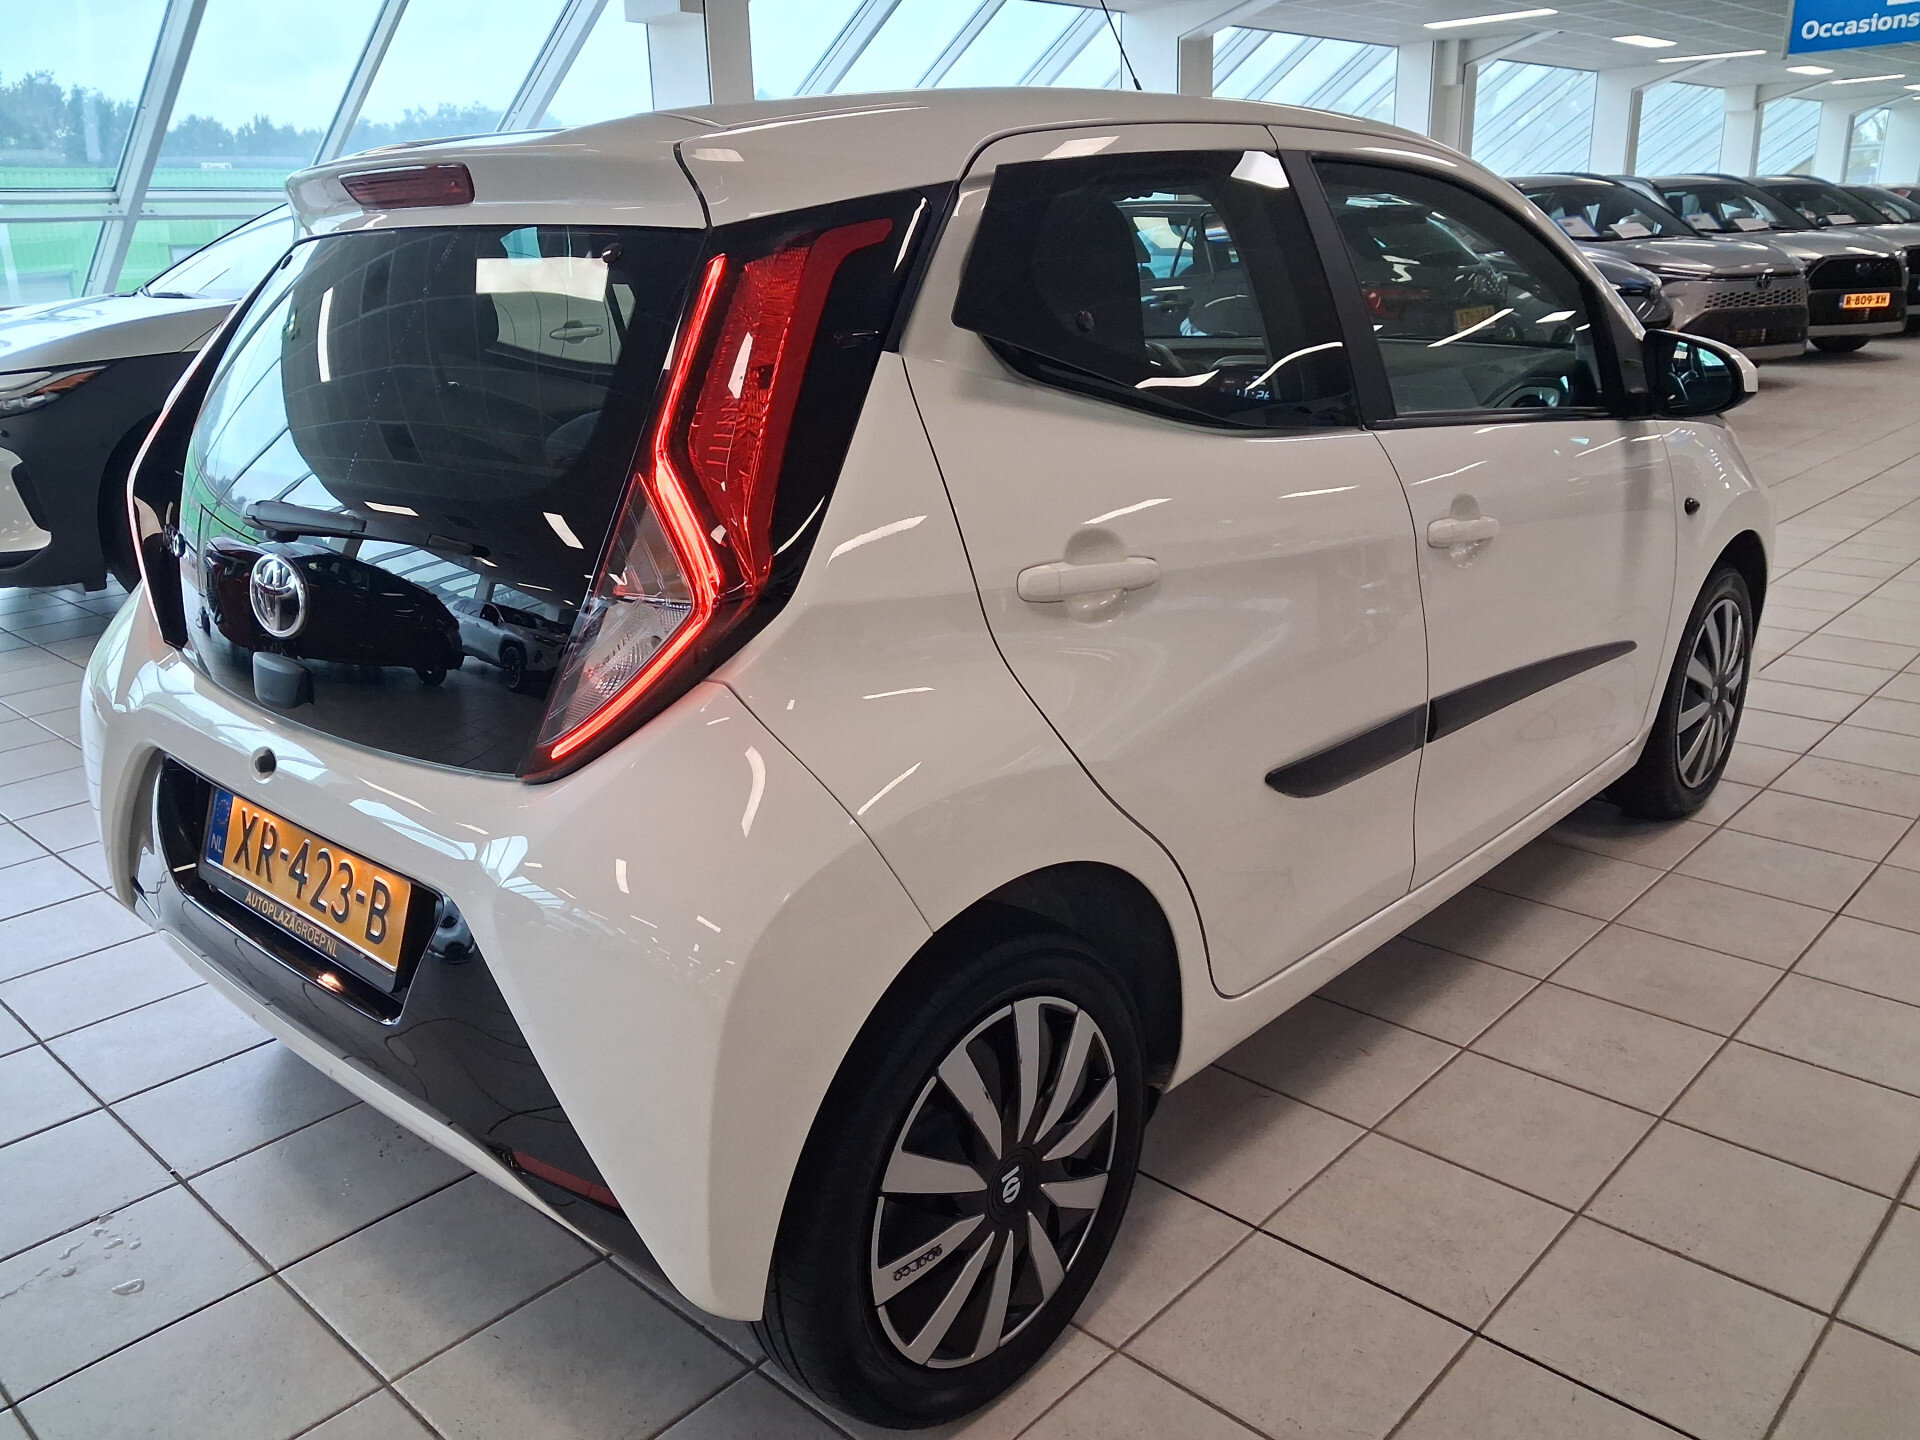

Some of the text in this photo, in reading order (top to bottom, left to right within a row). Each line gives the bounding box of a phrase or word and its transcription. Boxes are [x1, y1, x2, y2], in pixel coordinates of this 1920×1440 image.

[1801, 12, 1920, 40] Occasions
[210, 832, 223, 854] NL
[232, 806, 392, 945] XR-423-B
[245, 890, 338, 958] AUTOPLAZAGROEP.NL
